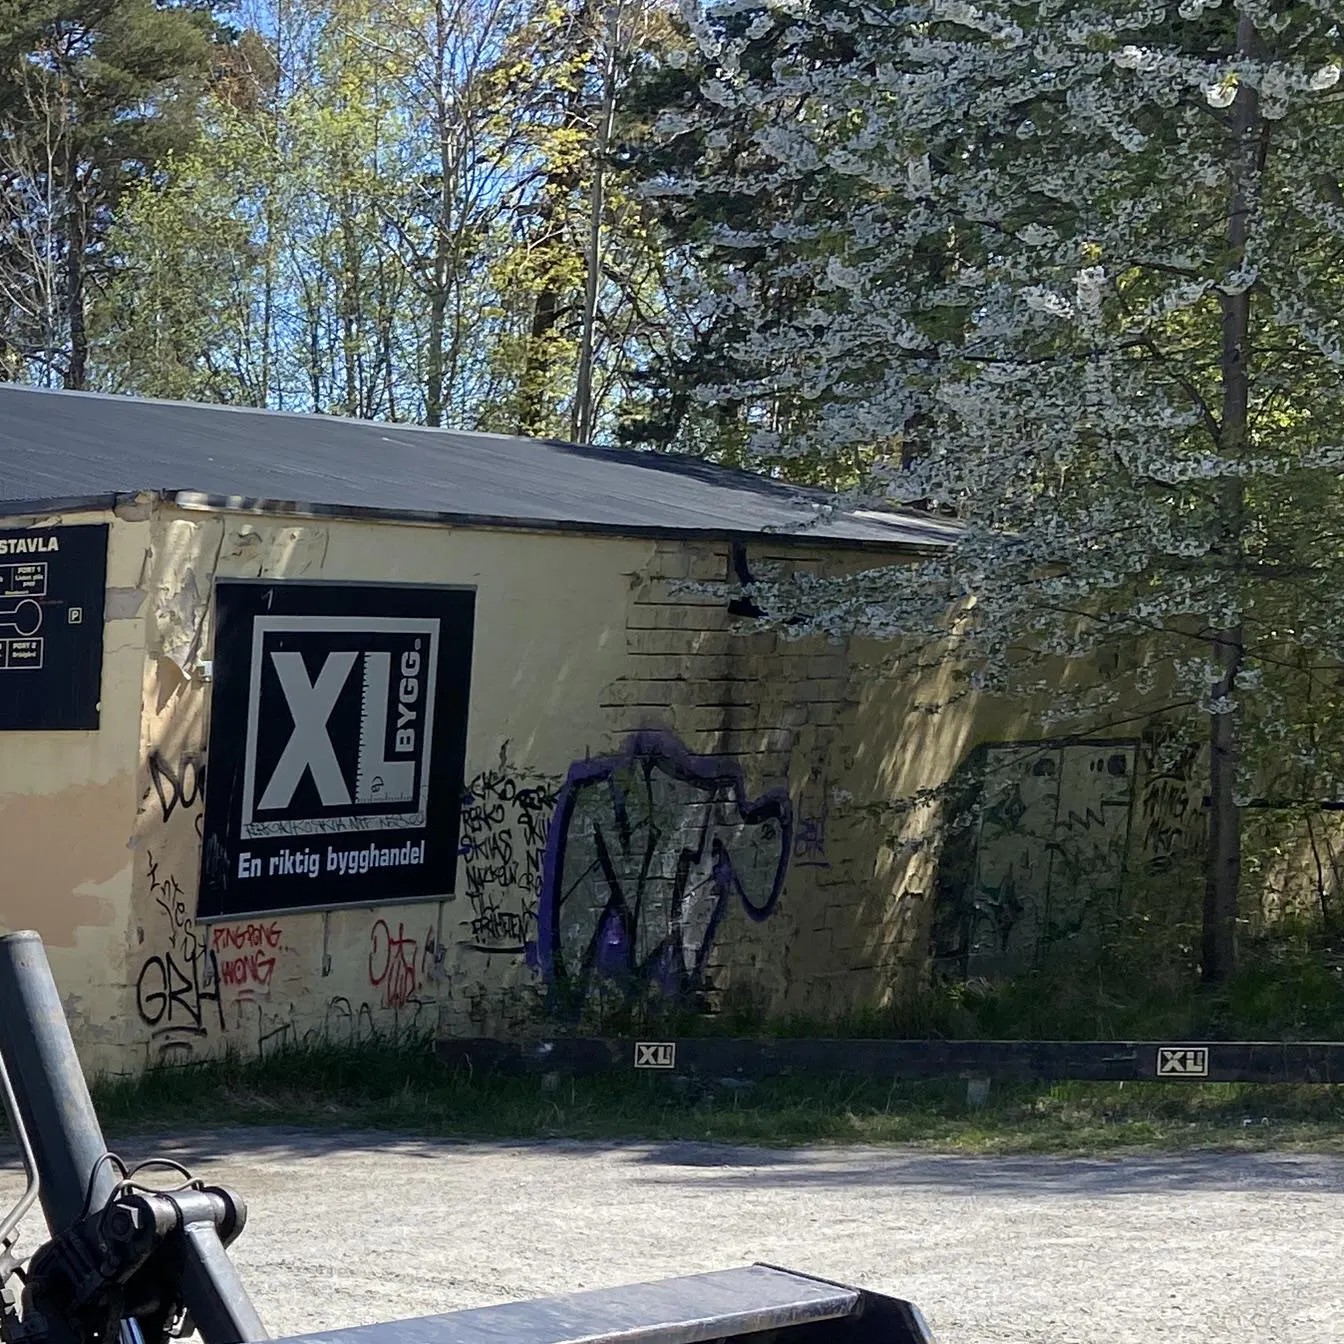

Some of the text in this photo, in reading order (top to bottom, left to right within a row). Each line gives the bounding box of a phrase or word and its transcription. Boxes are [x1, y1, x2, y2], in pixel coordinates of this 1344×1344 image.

[257, 651, 416, 810] XL
[238, 840, 425, 878] En riktig bygghandel
[1161, 1051, 1204, 1072] XL
